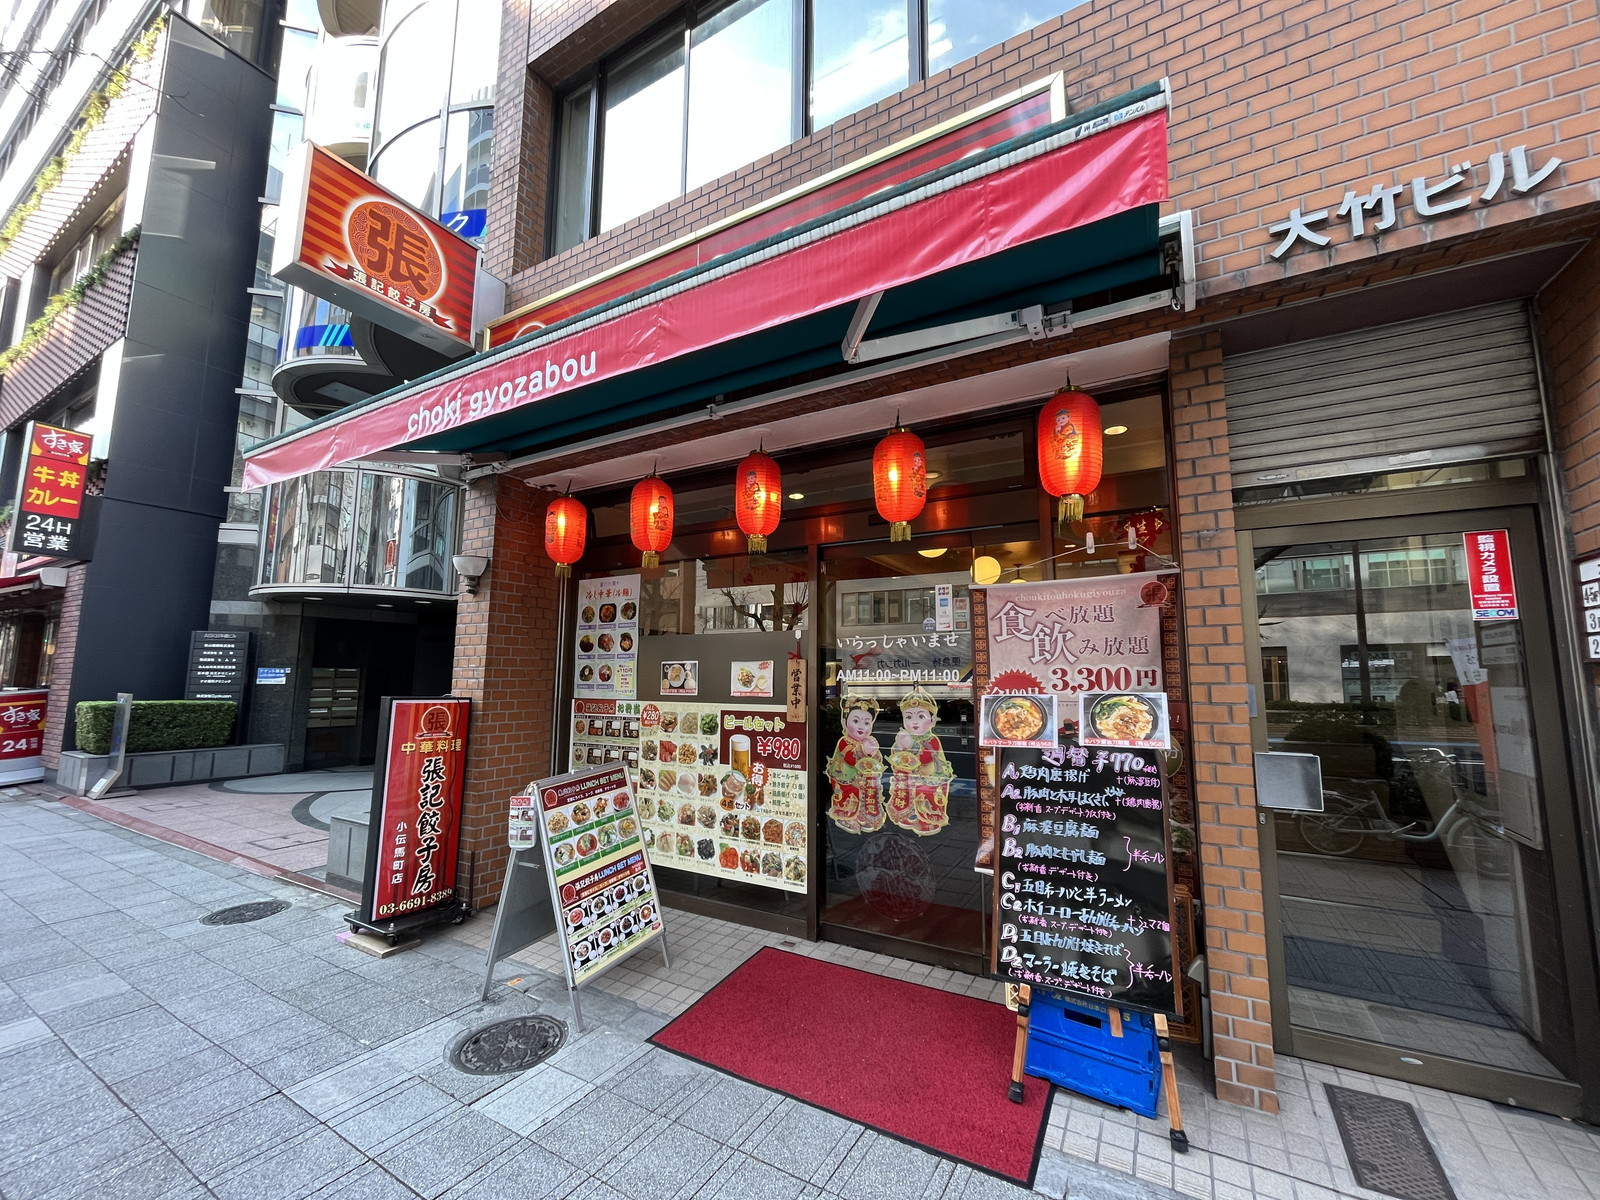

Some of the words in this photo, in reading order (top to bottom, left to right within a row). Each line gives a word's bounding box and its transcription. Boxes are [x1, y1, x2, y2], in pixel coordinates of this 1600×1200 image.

[1267, 143, 1563, 260] 大竹ビル
[366, 207, 430, 297] 張
[353, 270, 432, 318] 張記餃子房
[407, 391, 464, 435] choki
[467, 350, 598, 418] gyozabou
[41, 429, 84, 455] すき家
[32, 465, 80, 489] 牛丼
[26, 486, 79, 506] カレー
[25, 514, 72, 535] 24H
[23, 531, 70, 552] 営業
[1477, 534, 1501, 592] 監視カメラ設置
[993, 601, 1115, 643] 食べ放題
[1475, 609, 1515, 618] SECOM
[1589, 613, 1600, 630] 3
[837, 631, 959, 650] いらっしゃいませ
[1029, 622, 1150, 665] 飲み放題
[836, 669, 960, 682] AM11:00~PM11:00
[1052, 666, 1158, 695] 3,300円
[790, 668, 802, 710] 営業中
[1, 705, 41, 724] すき家
[427, 711, 447, 732] 張
[643, 711, 660, 721] ¥280
[723, 714, 786, 732] ビールセット
[2, 738, 28, 753] 24
[400, 738, 463, 756] 中華料理
[756, 736, 801, 760] ¥980
[579, 780, 600, 791] LUNCH
[599, 776, 610, 785] SET
[609, 771, 625, 782] MENU
[751, 762, 765, 787] お得
[411, 757, 446, 895] 張記餃子房
[391, 821, 408, 885] 小伝馬町店
[597, 865, 617, 879] LUNCH
[617, 859, 628, 871] SET
[627, 852, 642, 866] MENU
